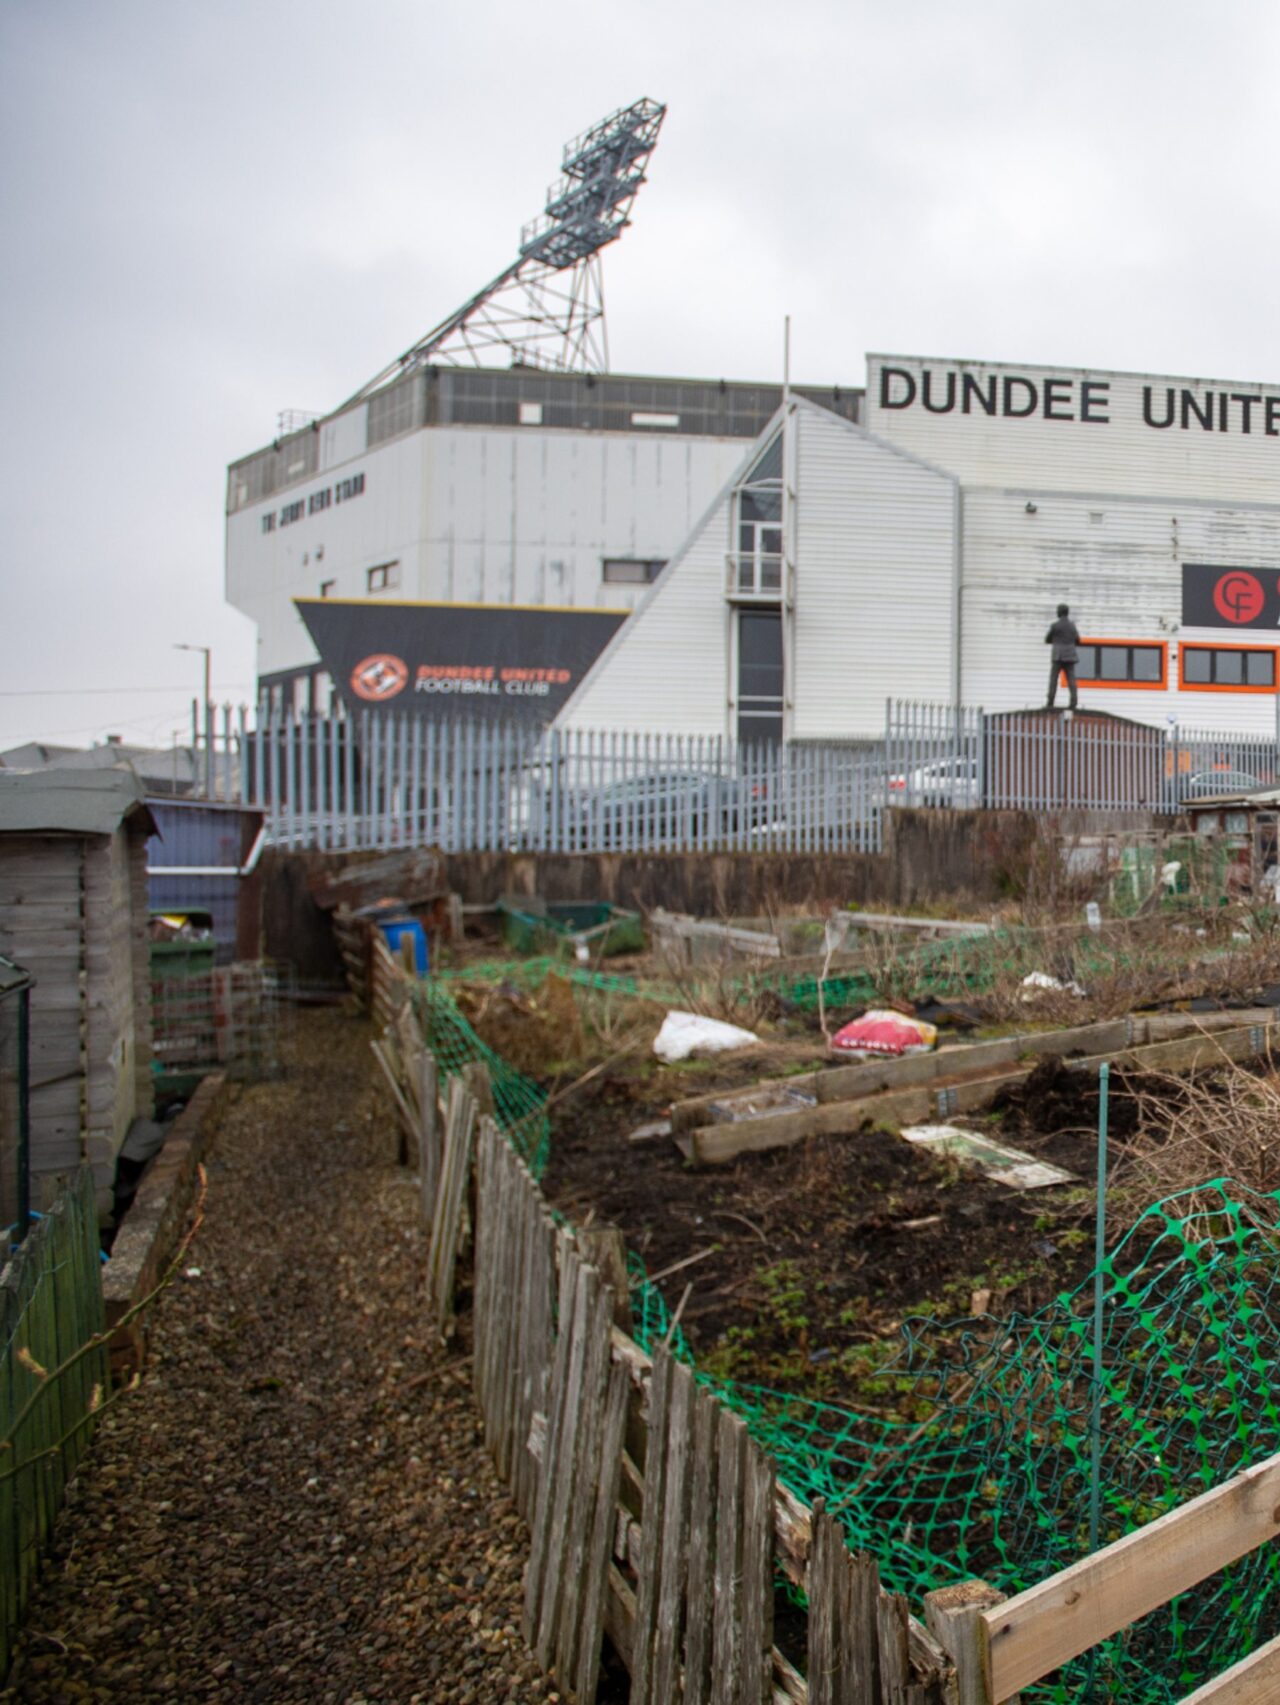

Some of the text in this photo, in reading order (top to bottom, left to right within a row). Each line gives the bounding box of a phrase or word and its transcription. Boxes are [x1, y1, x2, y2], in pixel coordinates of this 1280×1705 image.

[880, 366, 1111, 423] DUNDEE
[416, 664, 571, 684] DUNDEE UNITED
[414, 678, 549, 696] FOOTBALL CLUB
